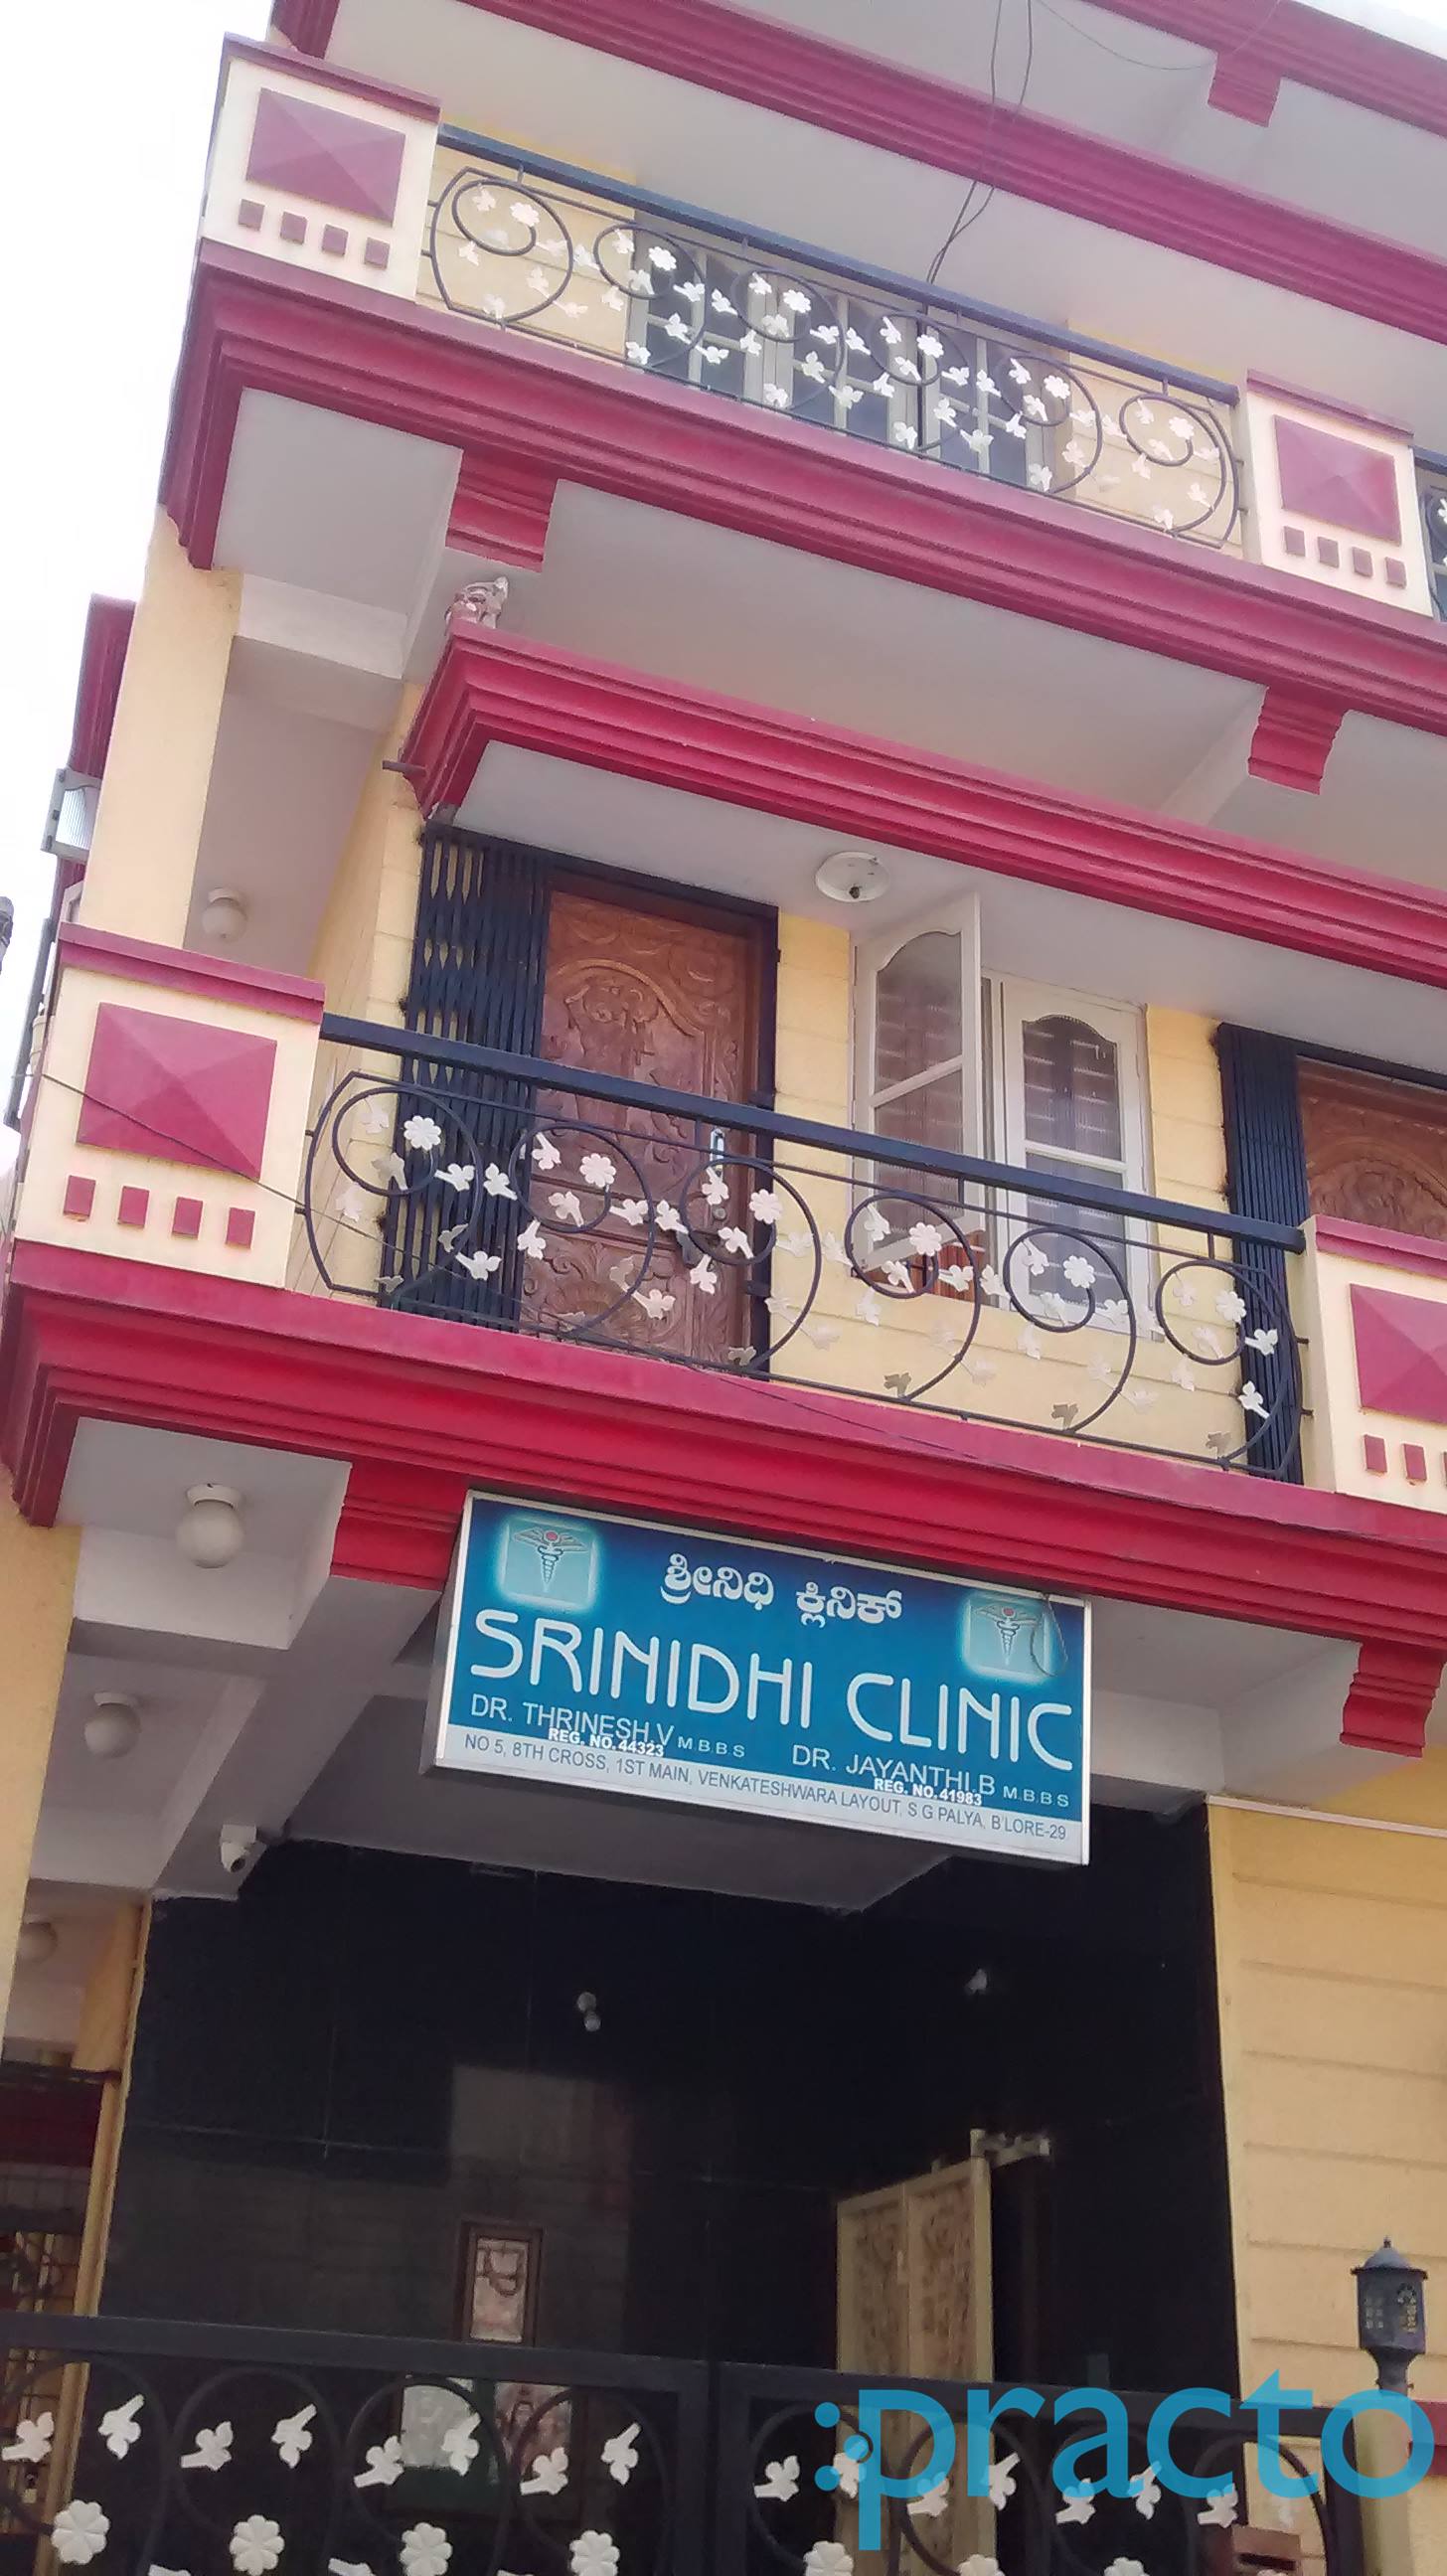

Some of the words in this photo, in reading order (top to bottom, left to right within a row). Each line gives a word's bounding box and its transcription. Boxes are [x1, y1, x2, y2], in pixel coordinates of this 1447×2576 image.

[471, 1609, 812, 1728] SRINIDHI
[847, 1674, 1072, 1771] CLINIC
[471, 1693, 513, 1722] DR.
[548, 1727, 585, 1746] REG.
[792, 1744, 837, 1772] DR.
[464, 1733, 490, 1751] NO
[494, 1737, 507, 1758] 5,
[512, 1742, 545, 1761] 8TH
[549, 1747, 610, 1773] CROSS,
[616, 1758, 647, 1777] 1ST
[648, 1762, 693, 1785] MAIN,
[698, 1769, 838, 1807] VENKATESHWARA
[907, 1802, 918, 1818] S
[921, 1805, 934, 1821] G
[874, 1777, 909, 1795] REG.
